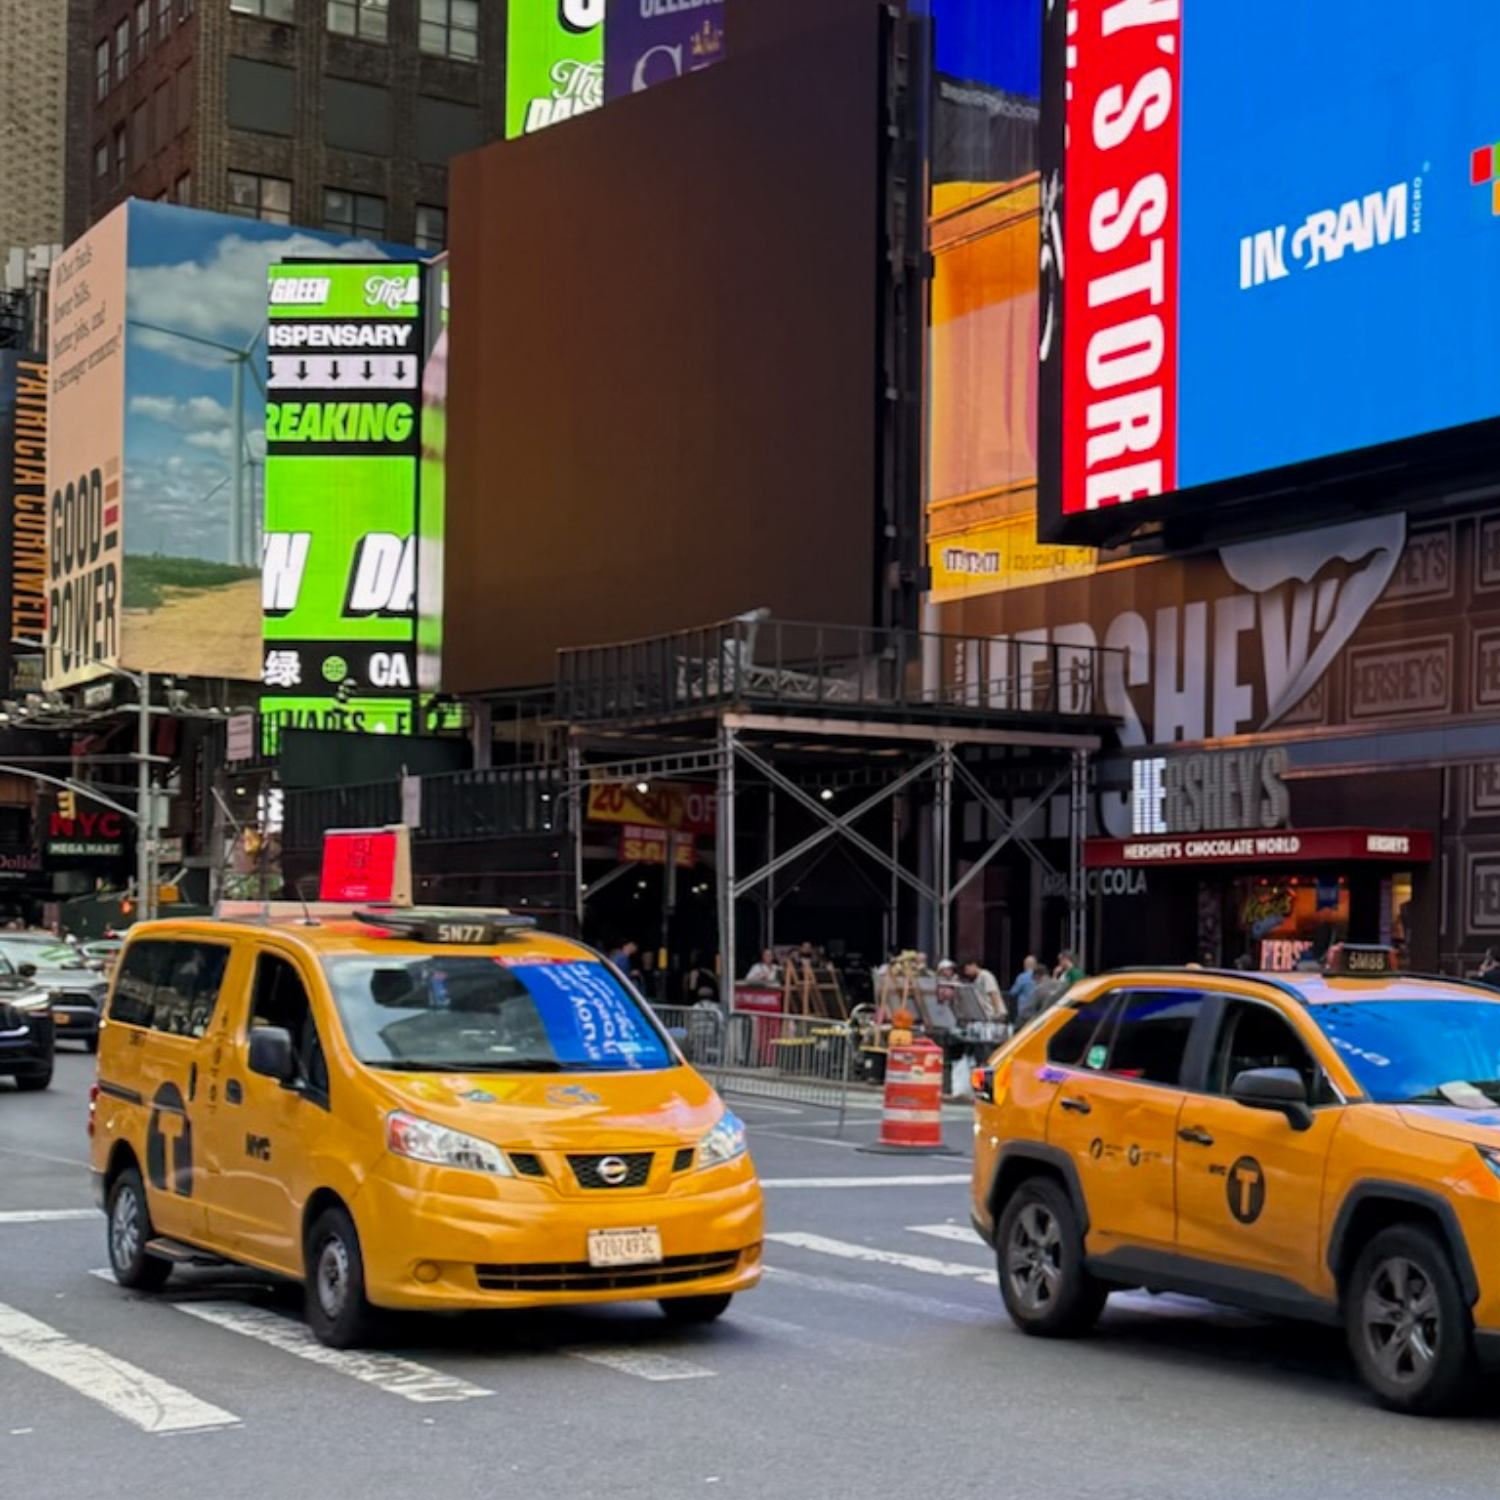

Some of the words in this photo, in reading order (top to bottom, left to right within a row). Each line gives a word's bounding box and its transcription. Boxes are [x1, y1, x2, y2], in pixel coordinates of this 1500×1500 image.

[1240, 182, 1407, 290] INGRAM
[51, 468, 102, 582] GOOD
[44, 561, 116, 679] POWER
[368, 652, 411, 687] CA
[1131, 748, 1289, 835] HERSHEY'S
[51, 812, 122, 837] NYC
[51, 842, 85, 854] MEGA
[624, 841, 696, 865] SAE
[1123, 841, 1183, 860] HERSHEY'S
[1185, 838, 1254, 857] CHOCOLATE
[1256, 836, 1300, 853] WORLD
[438, 925, 485, 942] 5N77
